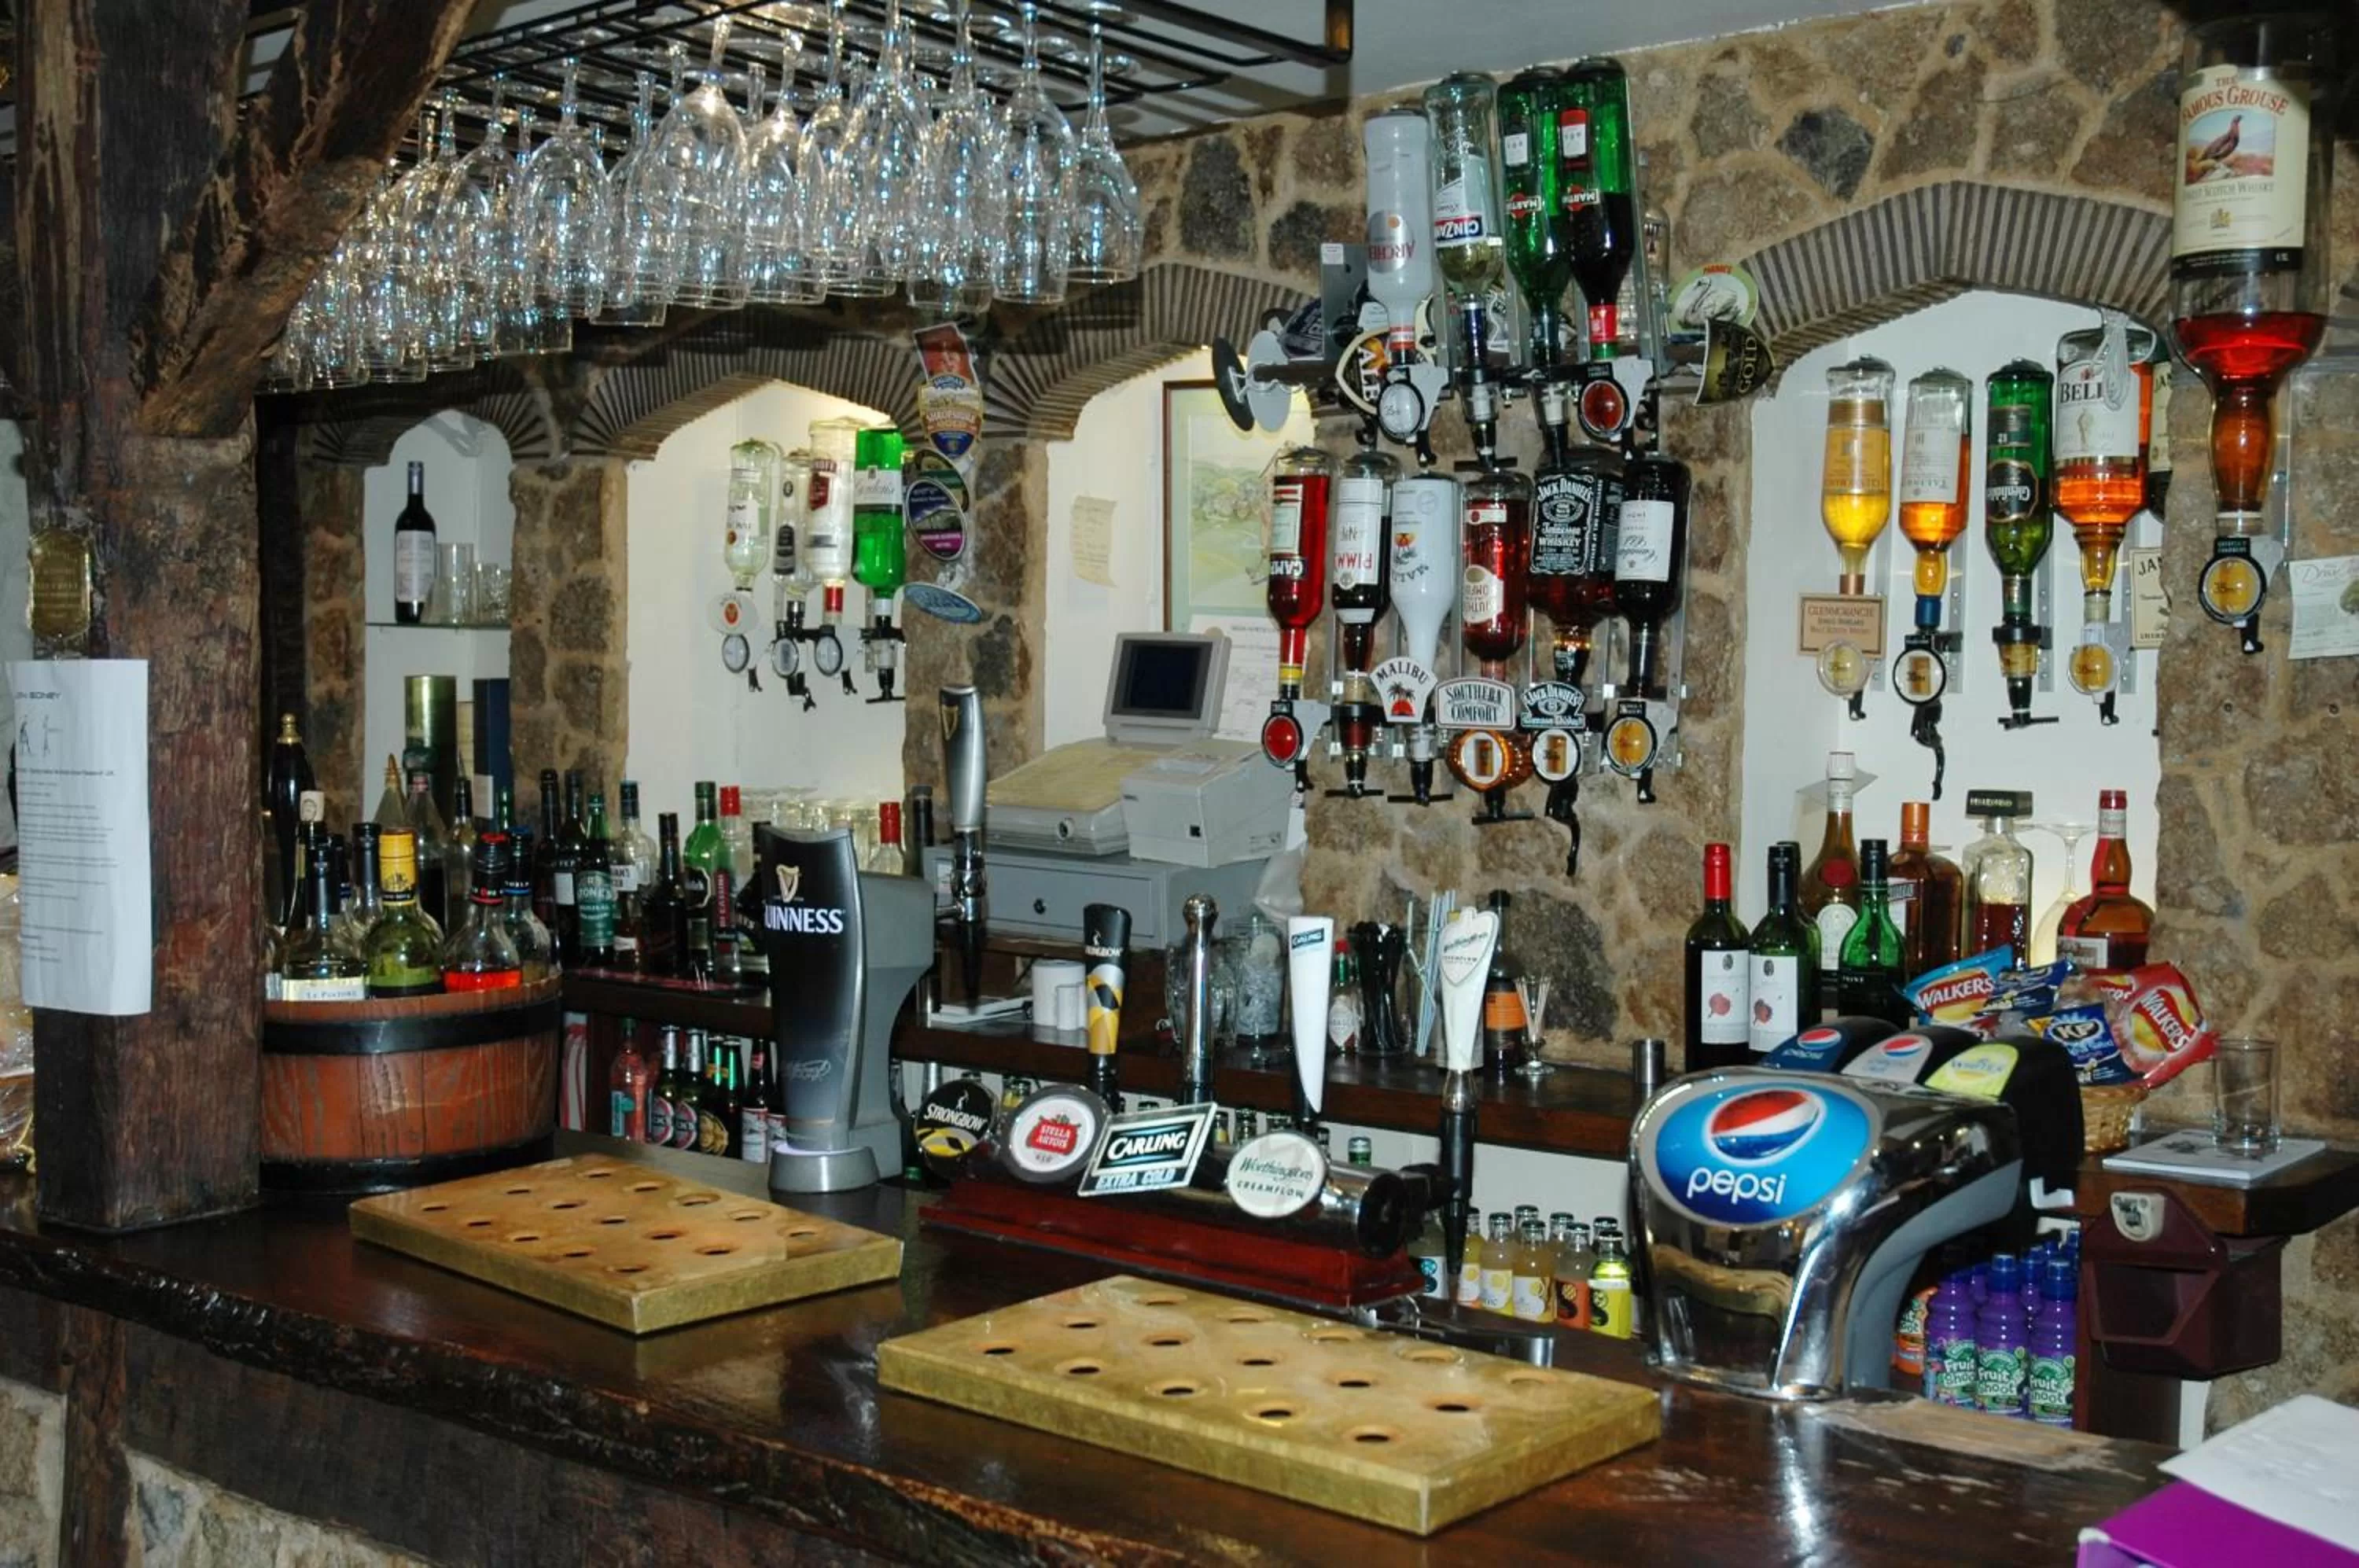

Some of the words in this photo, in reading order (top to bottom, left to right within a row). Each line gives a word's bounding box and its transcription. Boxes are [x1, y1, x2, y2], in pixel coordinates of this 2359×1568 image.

[2182, 89, 2225, 126] FAMOUS
[2226, 86, 2290, 117] GROUSE
[1737, 336, 1757, 395] GOLD
[1537, 481, 1560, 502] JACK
[1539, 536, 1582, 547] WHISKEY
[1376, 660, 1430, 686] MALIBU
[1444, 683, 1505, 705] SOUTHERN
[1523, 685, 1547, 706] JACK
[1450, 705, 1500, 724] COMFORT
[764, 904, 845, 934] UINNESS
[1916, 977, 1994, 1009] WALKERS
[2139, 988, 2190, 1051] WALKERS
[2056, 1023, 2095, 1039] KP
[923, 1102, 988, 1132] STRONGBOW
[1035, 1135, 1069, 1149] ARTOIS
[1040, 1124, 1071, 1139] STELLA
[1107, 1131, 1187, 1161] CARLING
[1094, 1172, 1139, 1191] EXTRA
[1139, 1167, 1177, 1186] COLD
[1236, 1180, 1305, 1199] CREAMFLOW
[1687, 1164, 1787, 1205] pepsi
[1944, 1358, 1976, 1373] Fruit
[1978, 1367, 2010, 1382] Fruit
